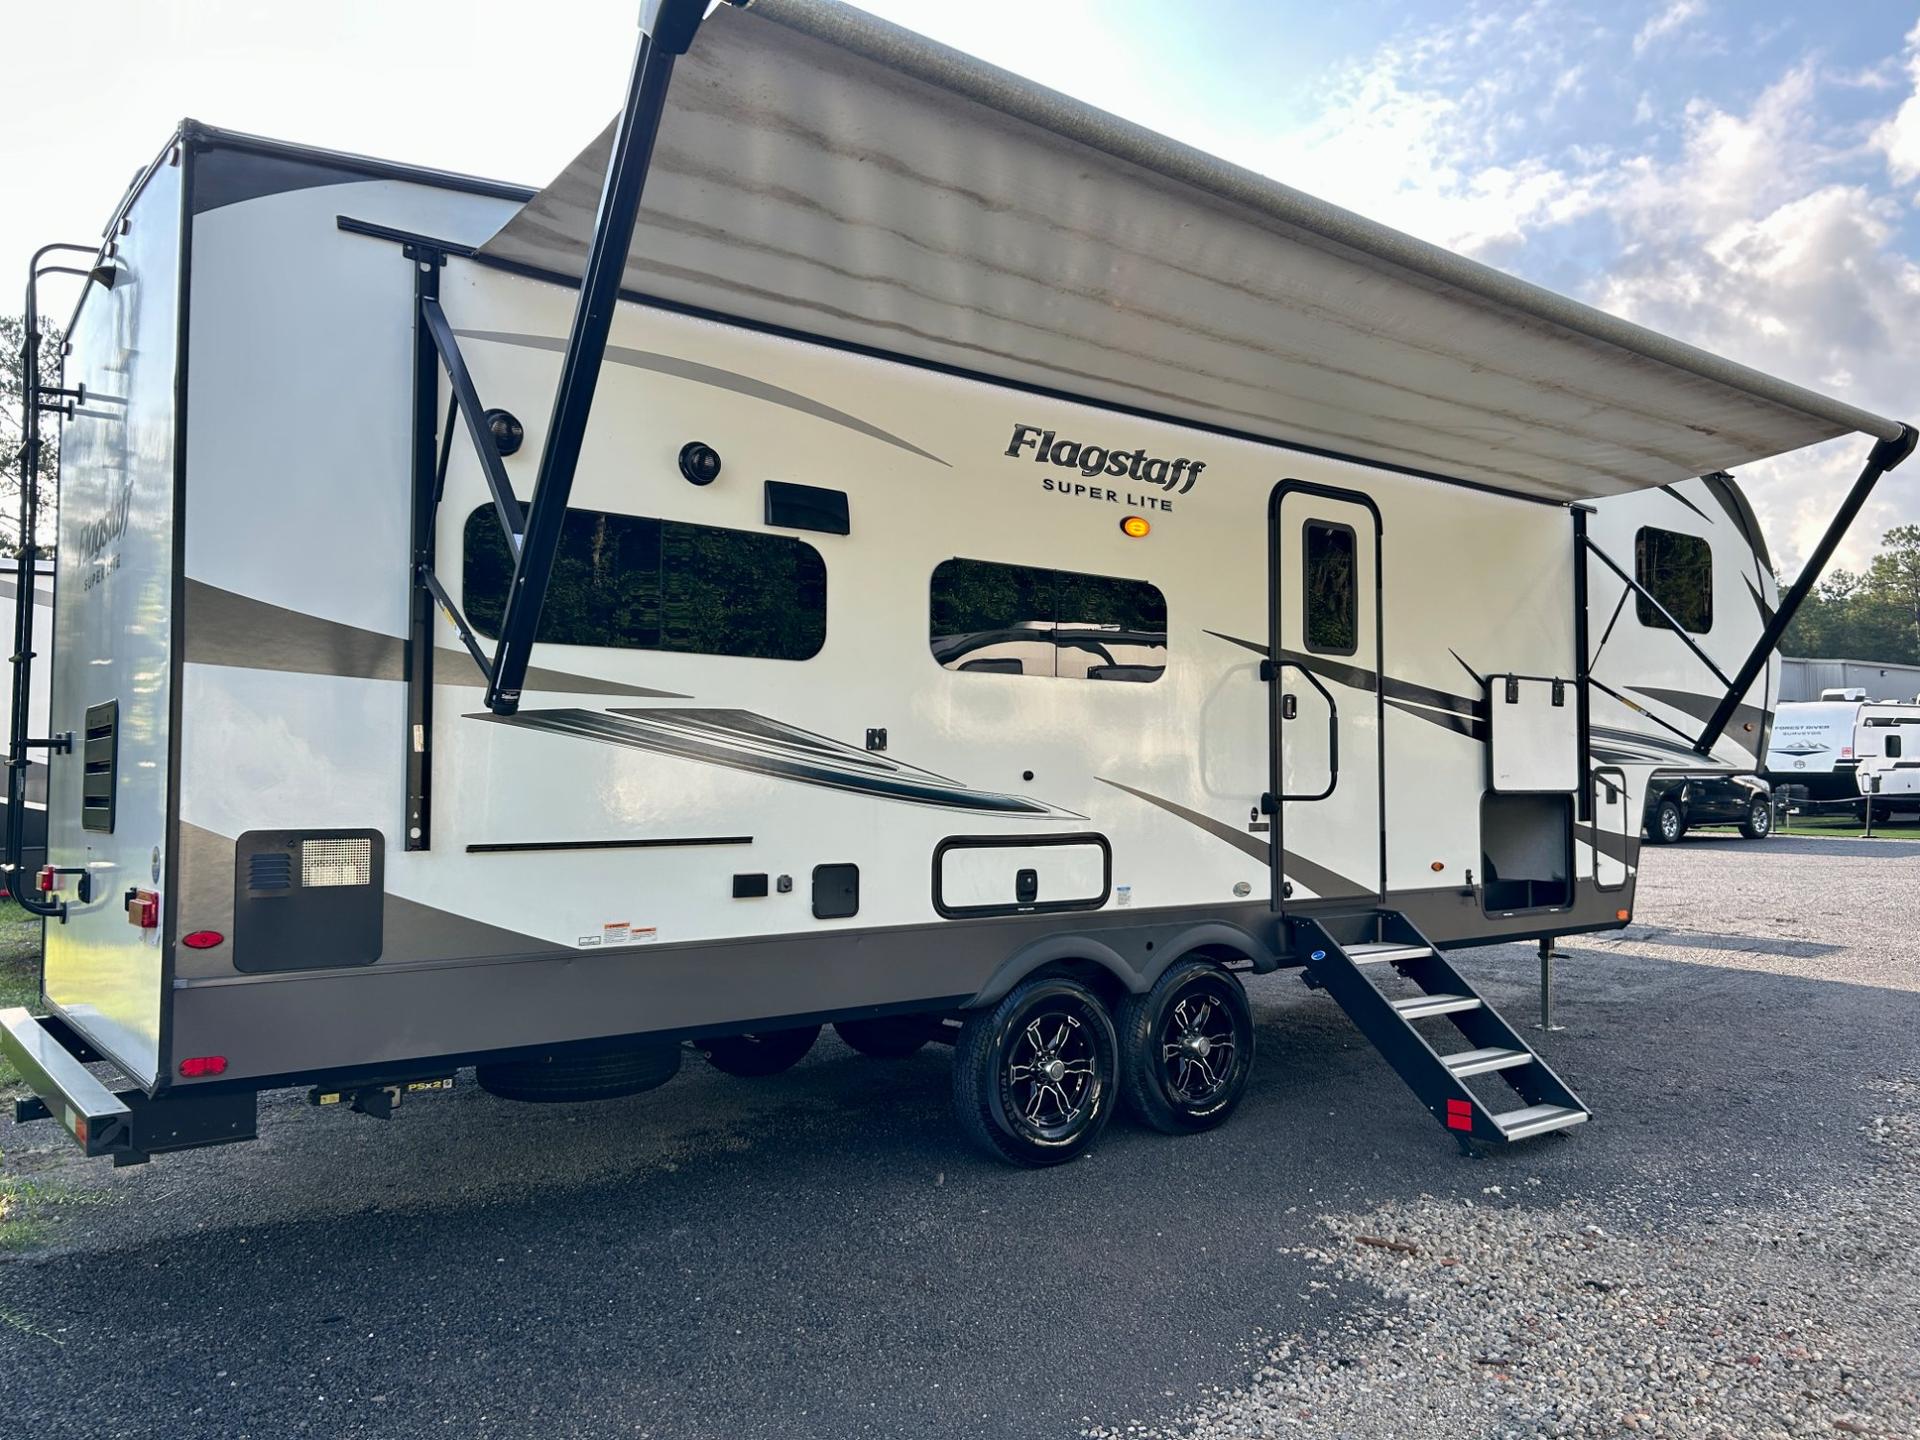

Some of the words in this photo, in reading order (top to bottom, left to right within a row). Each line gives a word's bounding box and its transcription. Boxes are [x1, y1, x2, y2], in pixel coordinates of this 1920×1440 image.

[1004, 423, 1207, 495] Flagstaff
[1042, 478, 1119, 504] SUPER
[1127, 493, 1173, 513] LITE
[408, 1080, 442, 1091] PSx2
